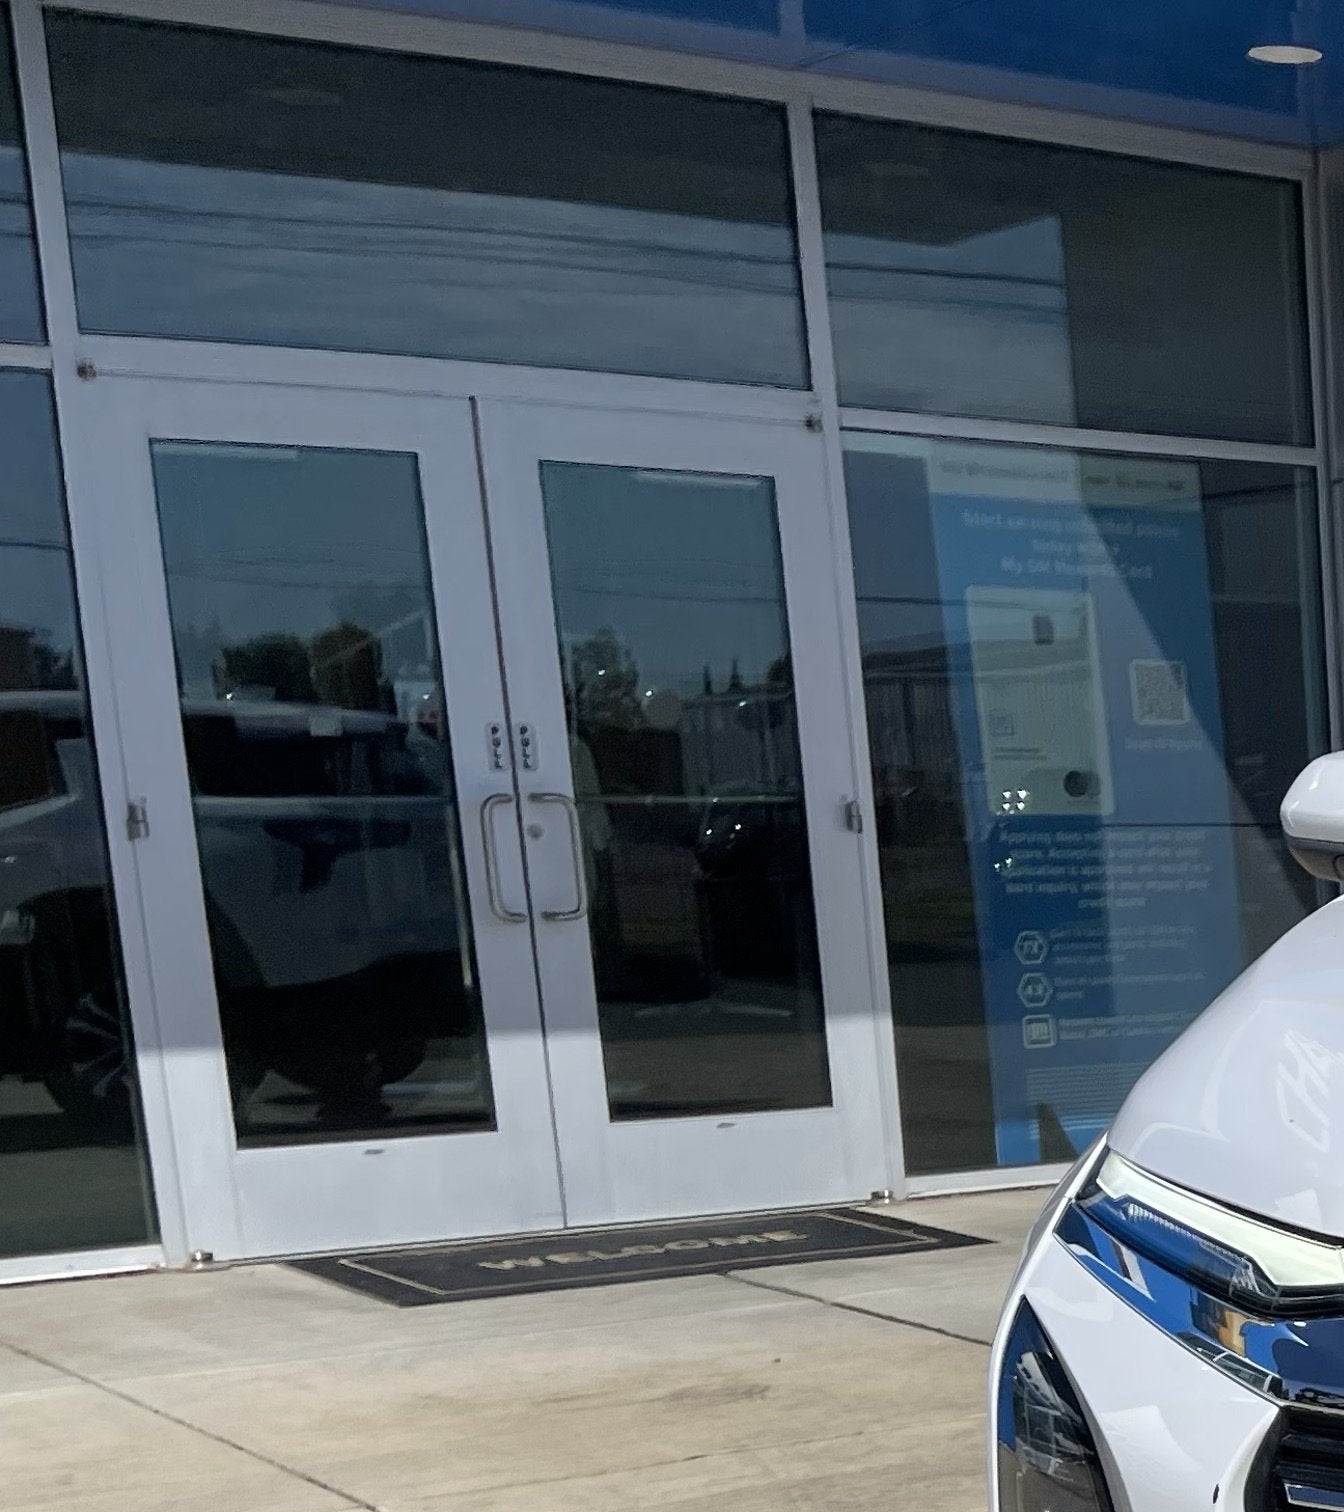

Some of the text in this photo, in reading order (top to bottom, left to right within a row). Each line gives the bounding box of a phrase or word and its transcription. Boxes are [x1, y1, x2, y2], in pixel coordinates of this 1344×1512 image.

[491, 725, 504, 769] PULL
[519, 725, 532, 769] PULL
[479, 1229, 807, 1271] WELCOME
